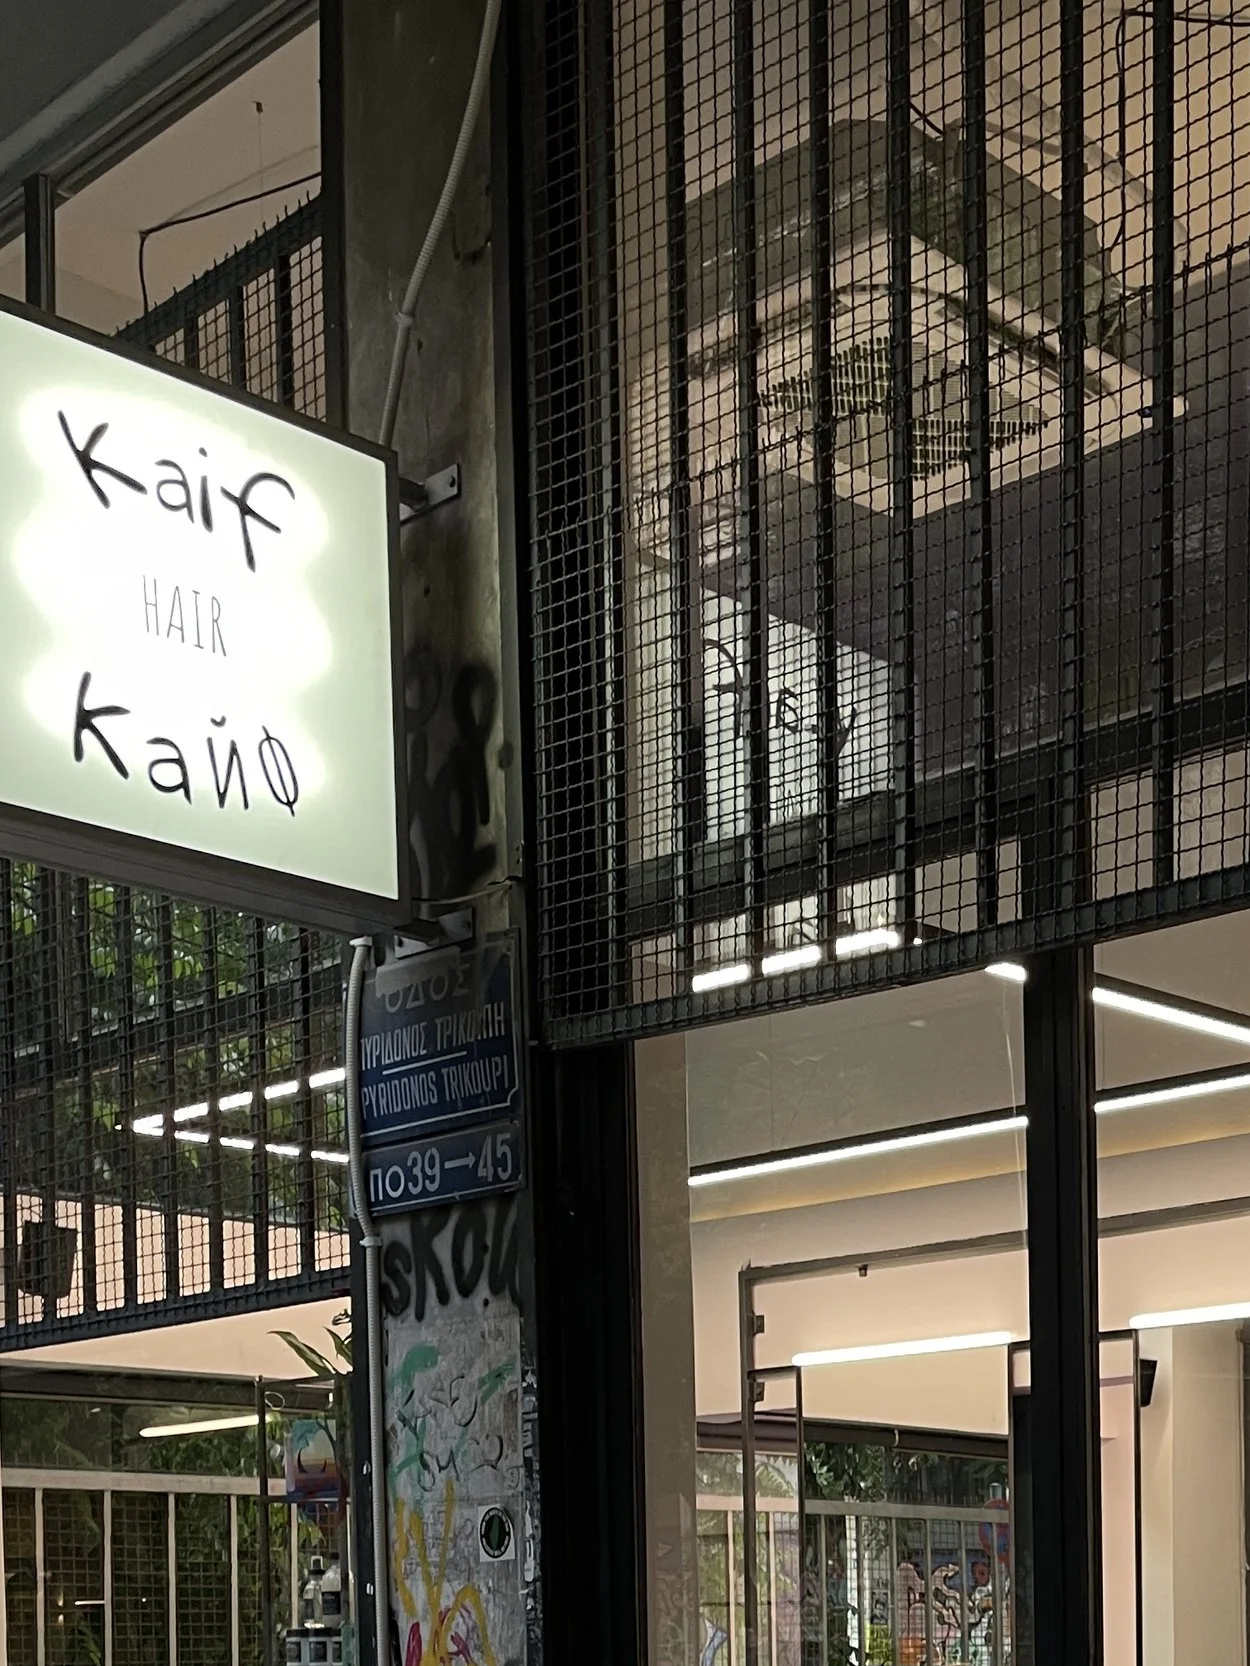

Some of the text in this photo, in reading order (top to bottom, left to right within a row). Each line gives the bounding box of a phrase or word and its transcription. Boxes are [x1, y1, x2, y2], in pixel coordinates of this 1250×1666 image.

[58, 410, 296, 572] Kaif
[142, 573, 227, 657] HAIR
[361, 1054, 509, 1120] PYRIDONOS TRIKOUPI
[406, 1147, 441, 1196] 39
[477, 1132, 512, 1182] 45
